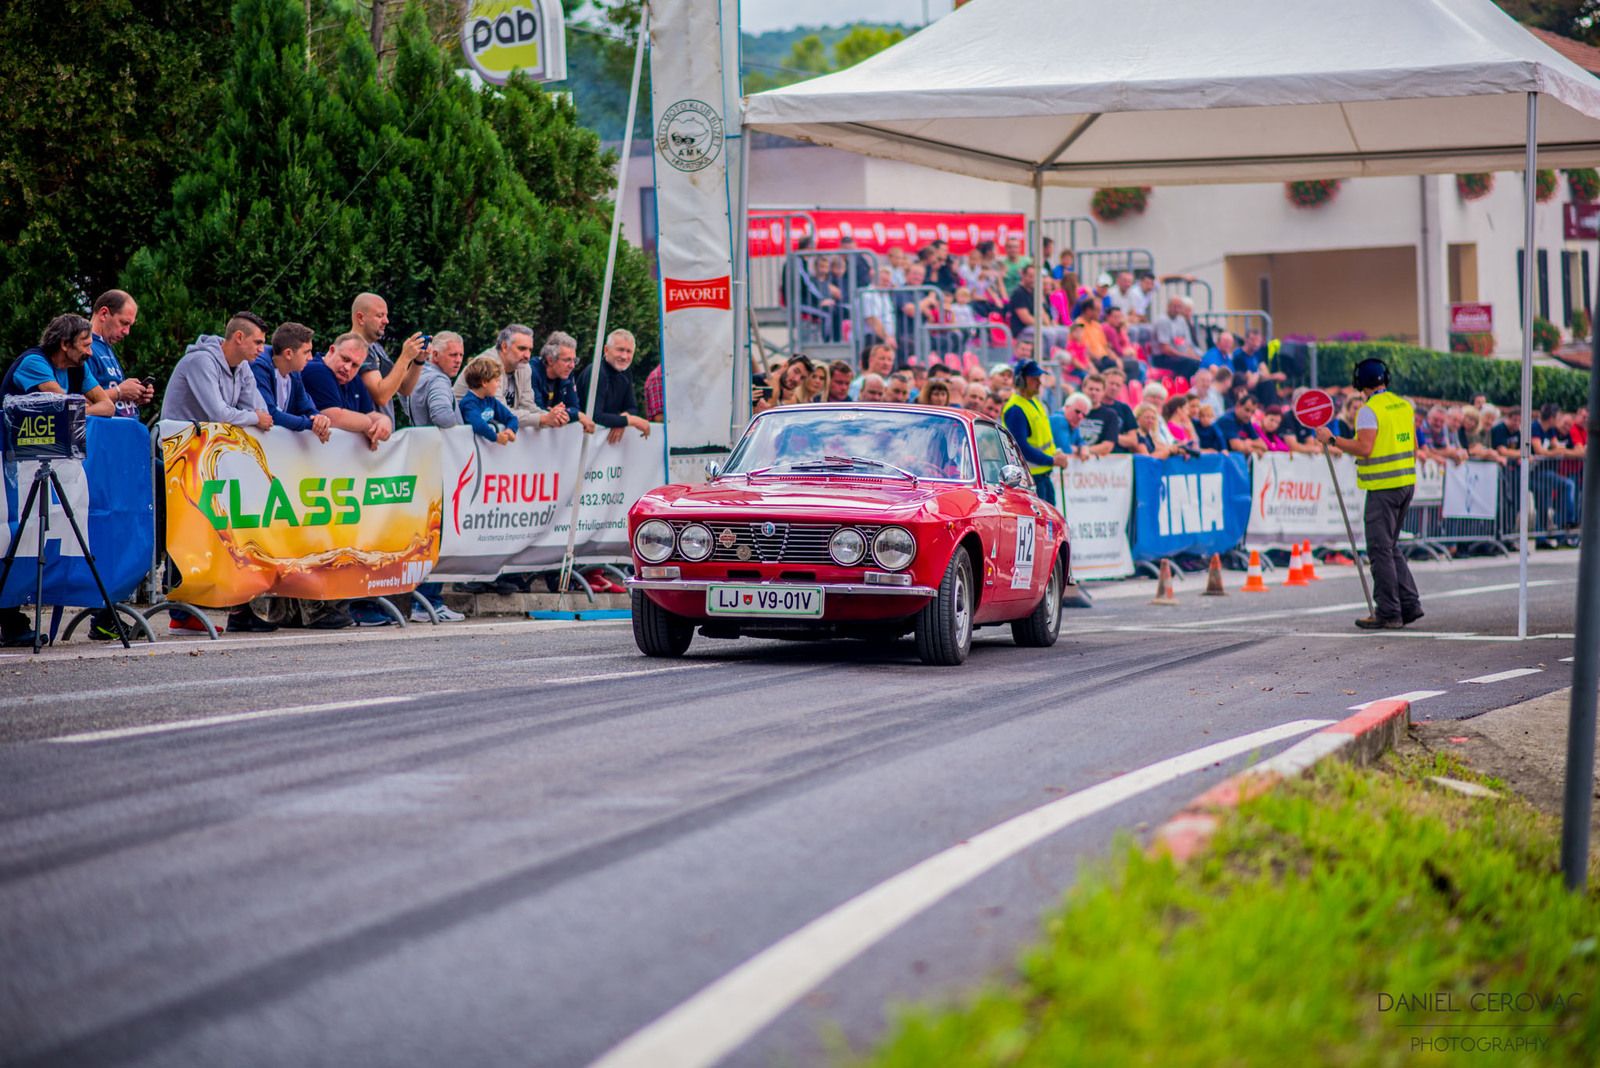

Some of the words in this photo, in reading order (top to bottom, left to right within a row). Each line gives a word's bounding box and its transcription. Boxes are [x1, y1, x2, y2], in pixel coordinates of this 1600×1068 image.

[473, 10, 537, 53] pab
[664, 103, 688, 122] MOTO
[689, 103, 713, 118] KLUB
[660, 124, 669, 150] AUTO
[669, 287, 727, 301] FAVORIT
[18, 415, 55, 437] ALGE
[369, 481, 410, 499] PLUS
[483, 473, 559, 504] FRIULI
[1277, 481, 1322, 501] FRIULI
[198, 476, 361, 530] CLASS
[1158, 472, 1224, 536] INA
[463, 505, 557, 530] antincendi
[1018, 522, 1034, 562] H2
[368, 577, 394, 590] powered
[393, 576, 400, 588] by
[720, 590, 739, 608] LJ
[758, 591, 812, 610] V9-01V
